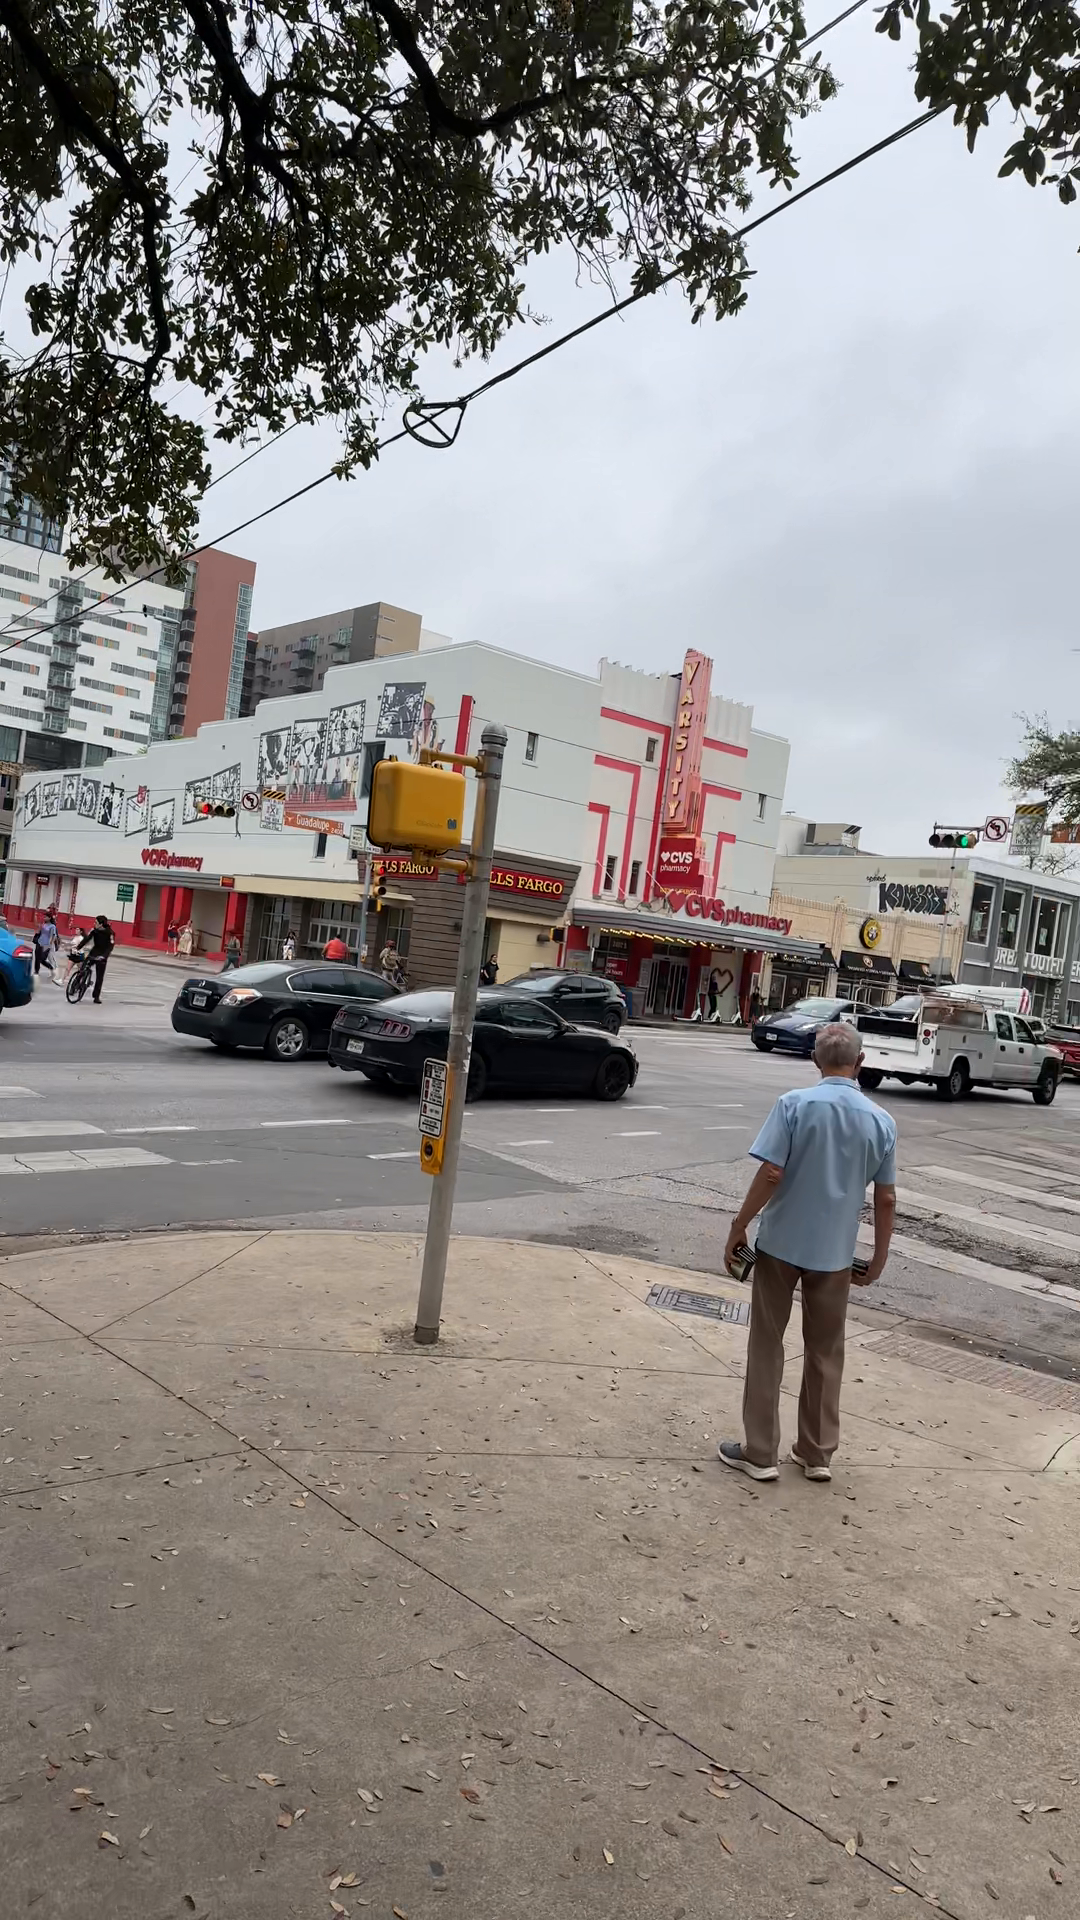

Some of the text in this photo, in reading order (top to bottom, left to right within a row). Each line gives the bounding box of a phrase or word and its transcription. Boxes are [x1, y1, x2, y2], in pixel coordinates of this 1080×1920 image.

[668, 660, 701, 819] VARSITY
[296, 813, 330, 831] Guadalupe
[149, 848, 203, 872] CVS pharmacy
[660, 864, 691, 873] pharmacy
[670, 851, 693, 864] CVS
[490, 871, 563, 894] LLS FARGO
[685, 894, 793, 936] CVS pharmacy
